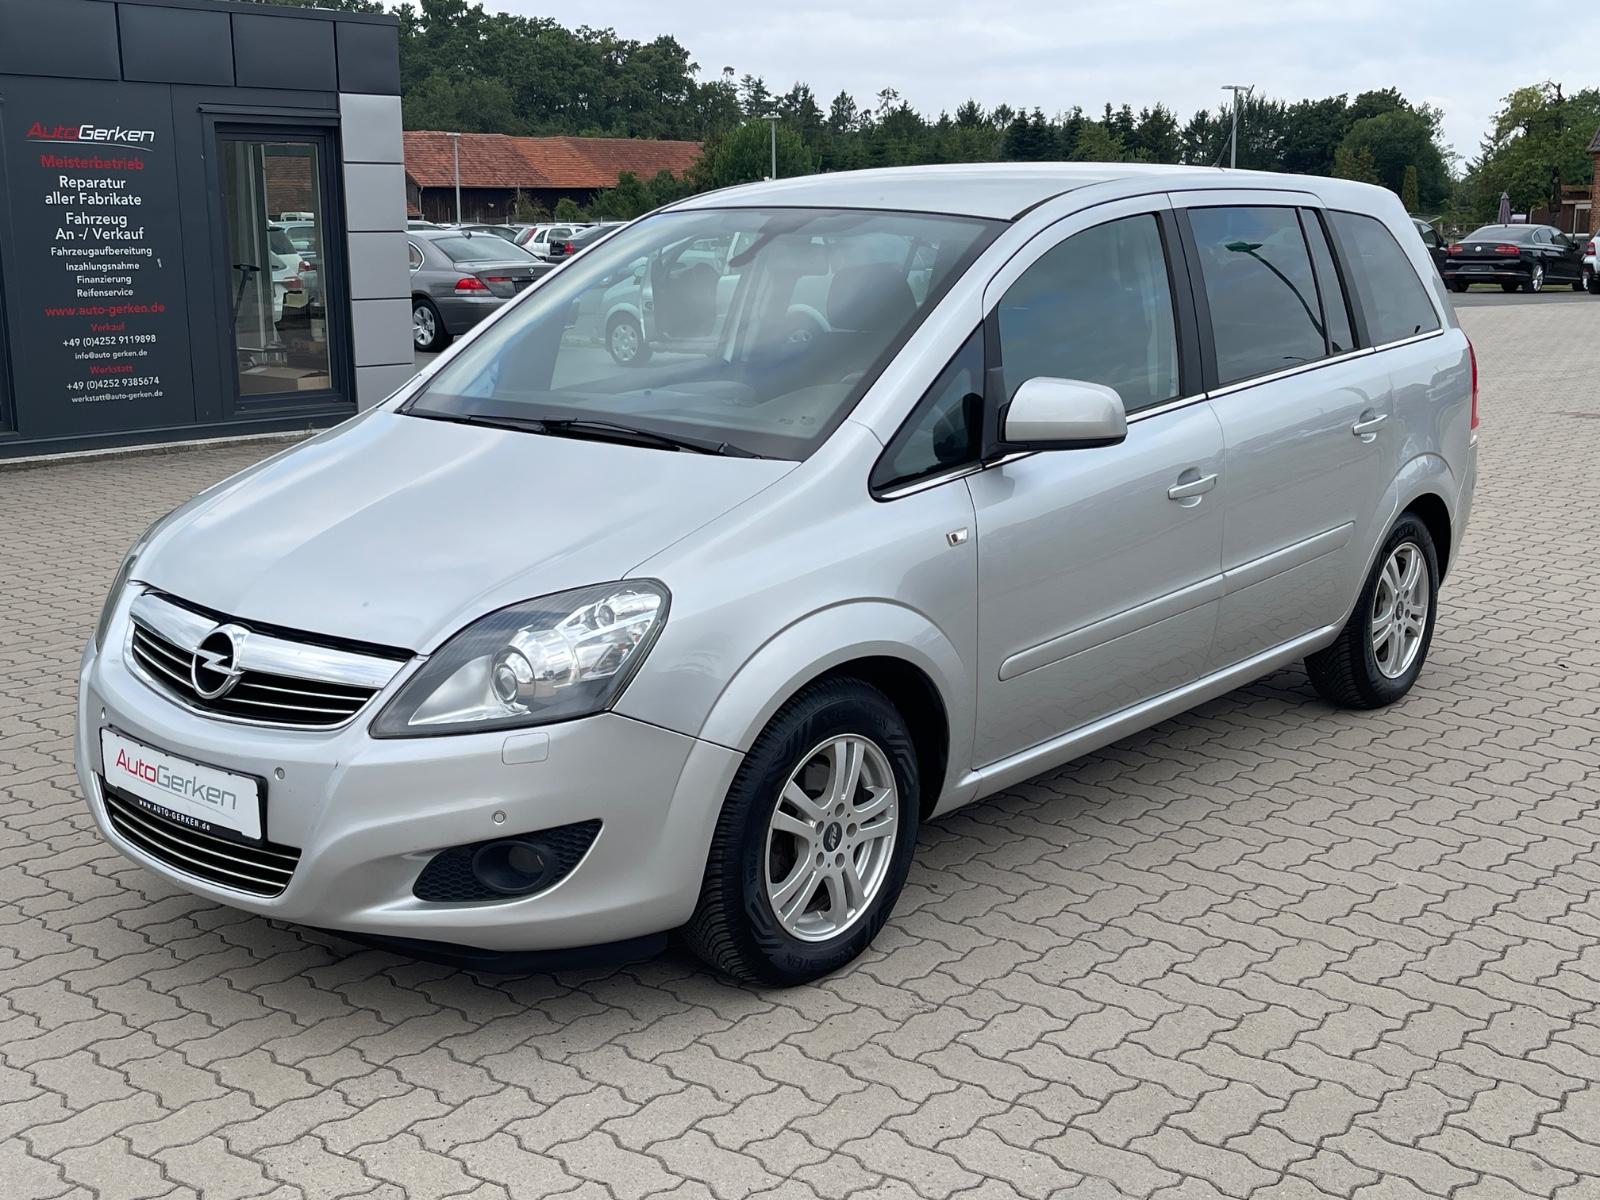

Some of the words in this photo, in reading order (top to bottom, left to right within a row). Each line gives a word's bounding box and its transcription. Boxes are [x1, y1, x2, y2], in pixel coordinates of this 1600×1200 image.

[26, 121, 155, 142] AutoGerken
[40, 153, 144, 170] Meisterbetrieb
[59, 175, 126, 191] Reparatur
[45, 192, 75, 205] aller
[79, 193, 142, 205] Fabrikate
[65, 212, 128, 227] Fahrzeug
[55, 228, 75, 240] An
[92, 227, 144, 240] Verkauf
[50, 246, 153, 257] Fahrzeugaufbereitung
[65, 262, 140, 272] Inzahlungsnahme
[76, 275, 132, 285] Finanzierung
[76, 288, 134, 298] Reifenservice
[44, 302, 165, 317] www.auto-gerken.de
[90, 322, 125, 332] Verkauf
[62, 338, 81, 347] +49
[82, 336, 117, 348] (0)4252
[118, 334, 157, 345] 9119898
[89, 364, 133, 374] Werkstatt
[66, 381, 84, 390] +49
[86, 379, 120, 391] (0)4252
[121, 376, 160, 387] 9385674
[71, 389, 164, 403] werkstatt@auto-gerken.de
[115, 748, 237, 810] AutoGerken
